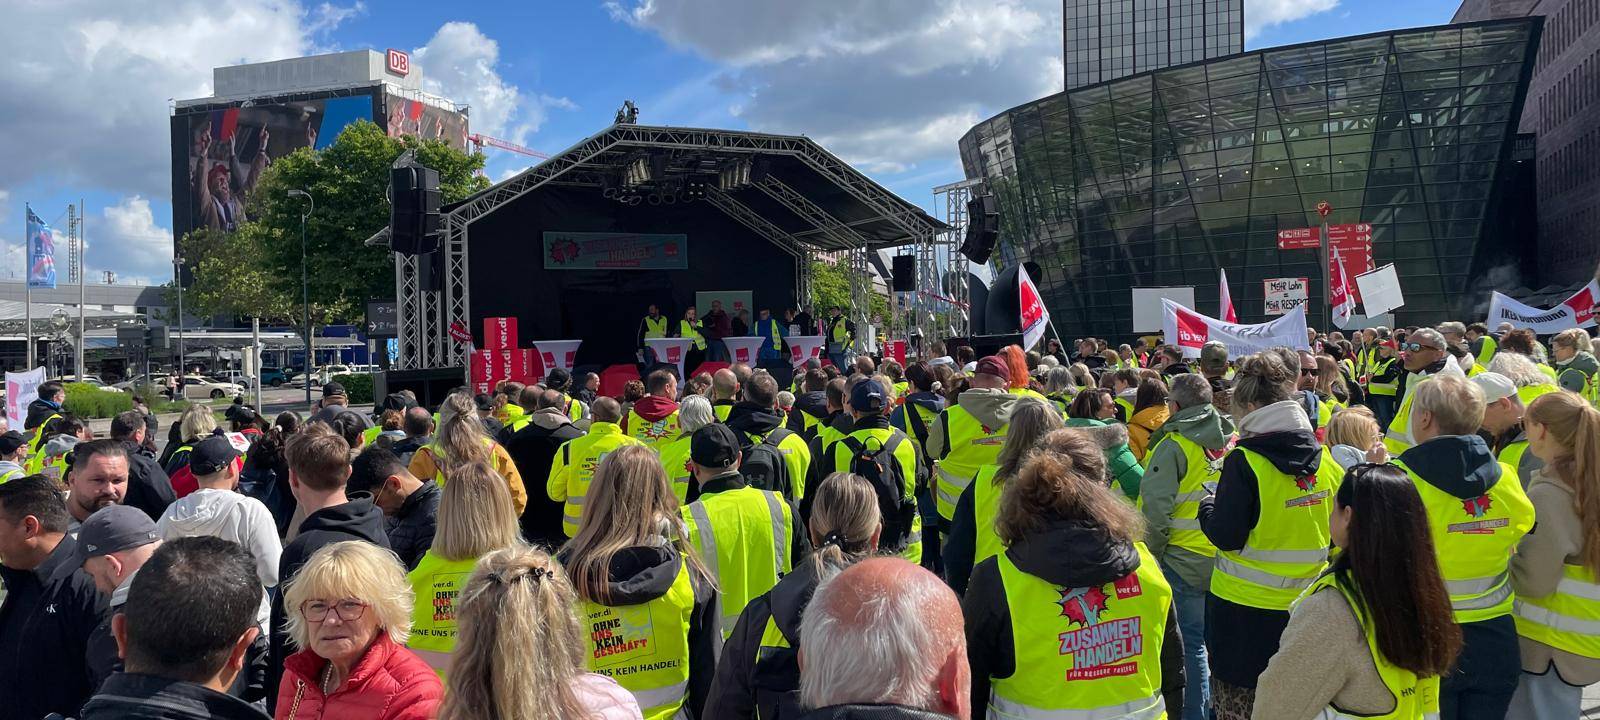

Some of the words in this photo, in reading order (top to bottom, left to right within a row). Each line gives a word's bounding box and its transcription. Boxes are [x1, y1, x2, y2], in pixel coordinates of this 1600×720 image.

[391, 52, 407, 70] DB
[499, 317, 508, 349] ver.di
[483, 349, 492, 382] ver.di
[589, 608, 612, 620] ver.di
[593, 618, 621, 632] OHNE
[591, 629, 612, 641] UNS
[596, 635, 624, 650] KEIN
[1060, 617, 1139, 654] ZUSAMMEN
[1074, 635, 1141, 668] HANDELN
[616, 666, 638, 676] KEIN
[640, 659, 681, 672] HANDEL!
